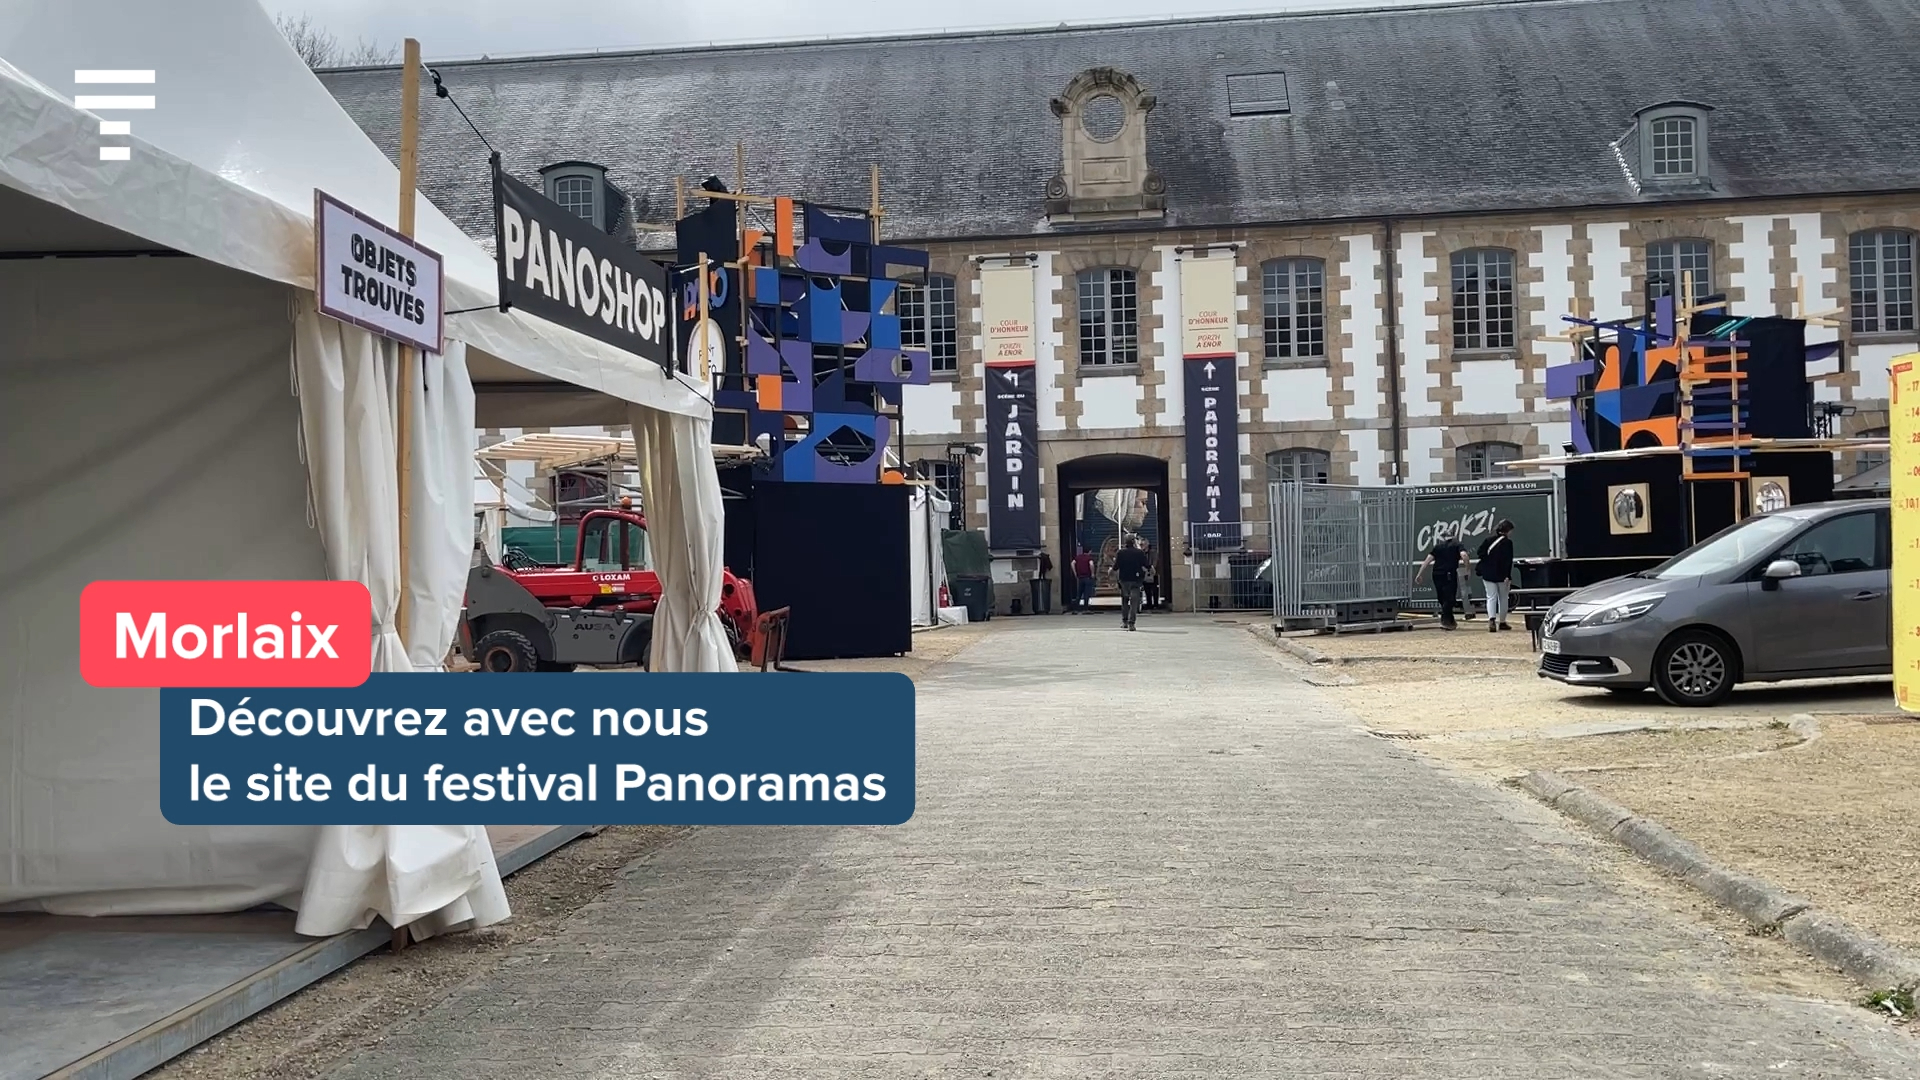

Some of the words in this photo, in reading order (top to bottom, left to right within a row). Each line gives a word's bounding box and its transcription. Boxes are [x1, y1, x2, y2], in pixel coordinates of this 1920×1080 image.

[351, 233, 417, 287] OBJETS
[503, 203, 666, 345] PANOSHOP
[341, 264, 425, 325] TROUVÉS
[1188, 317, 1228, 325] D'HONNEUR
[1005, 404, 1024, 509] JARDIN
[1204, 397, 1221, 522] PANORA'MIX
[575, 623, 614, 631] AUSA
